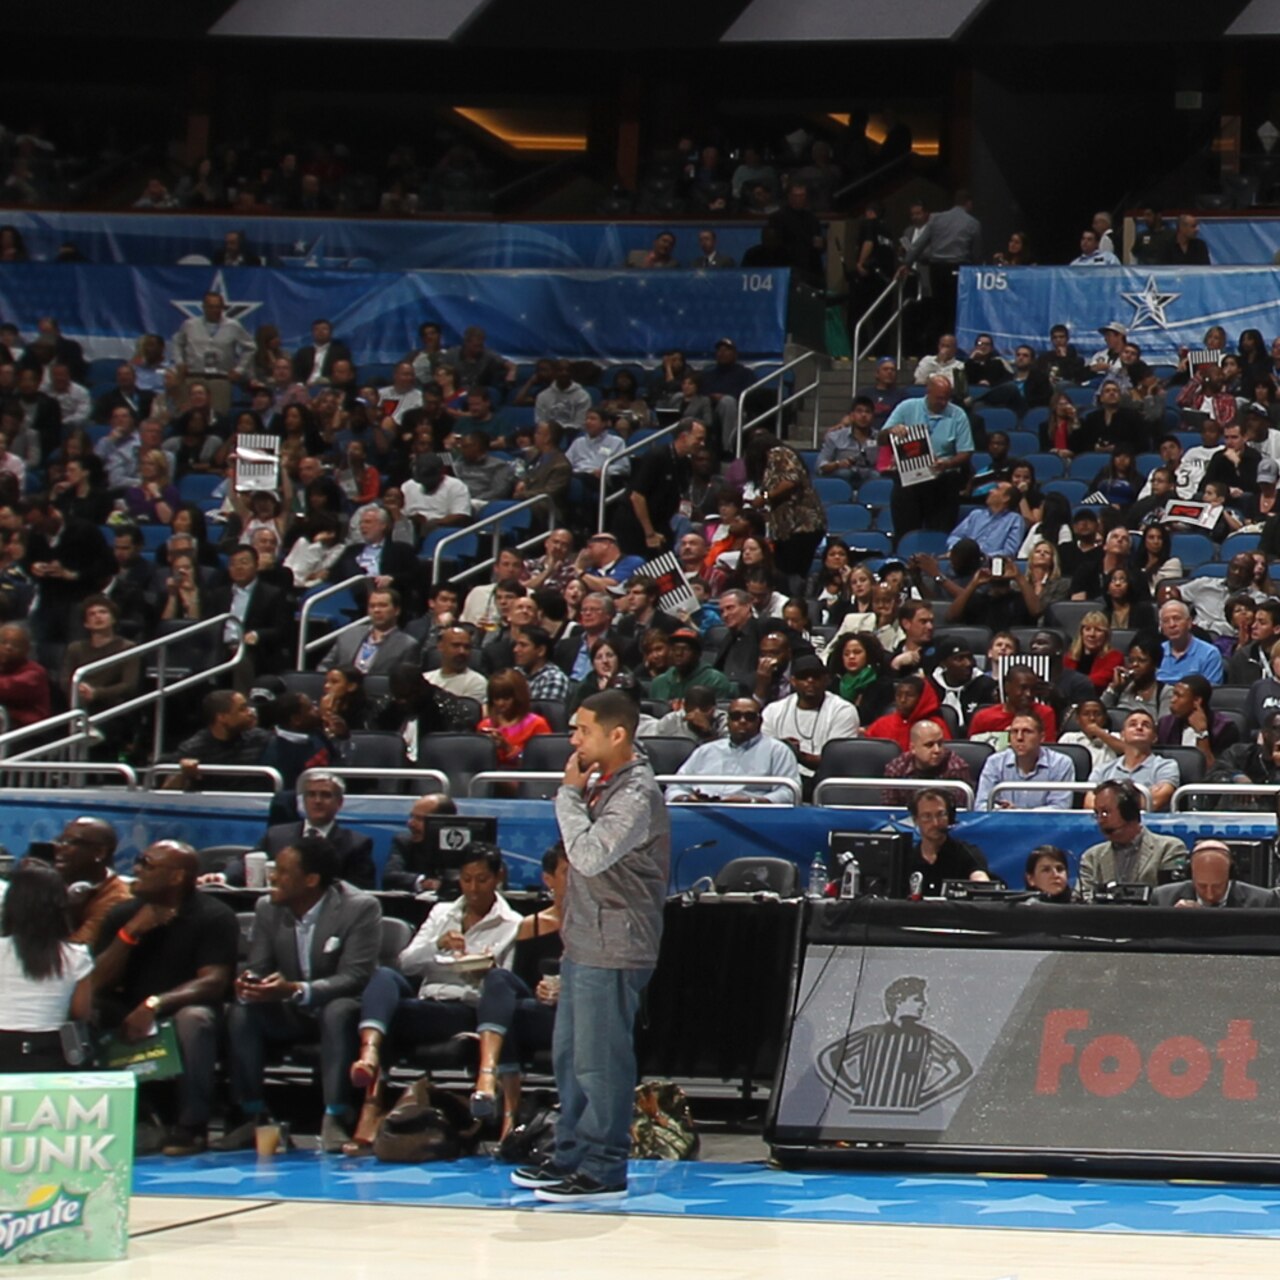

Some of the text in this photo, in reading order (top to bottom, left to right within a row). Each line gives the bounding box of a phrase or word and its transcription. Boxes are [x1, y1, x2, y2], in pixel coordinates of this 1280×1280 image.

[741, 273, 774, 291] 104
[976, 272, 1008, 290] 105
[1035, 1008, 1259, 1101] Foot
